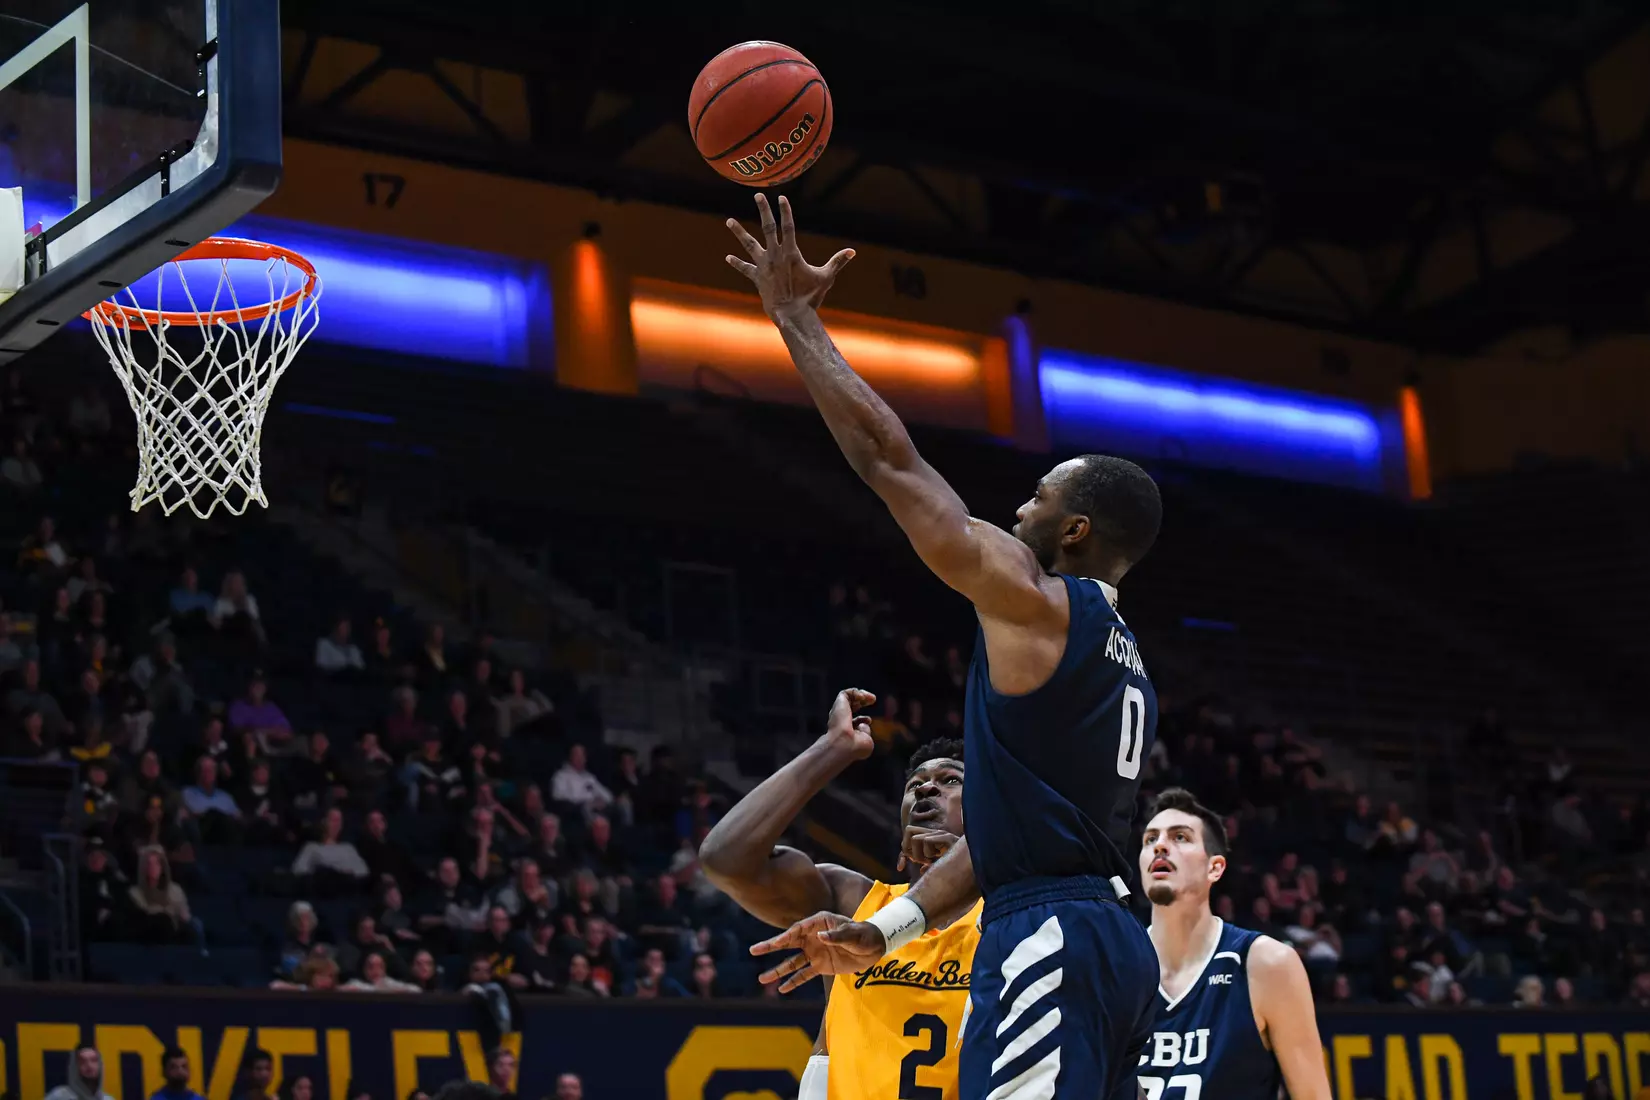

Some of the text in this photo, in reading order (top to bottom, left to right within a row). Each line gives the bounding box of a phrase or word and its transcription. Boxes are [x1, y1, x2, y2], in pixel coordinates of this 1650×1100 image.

[728, 112, 815, 177] Wilson
[363, 172, 405, 209] 17
[1105, 626, 1150, 681] ACQUA
[1117, 684, 1145, 780] 0
[1208, 973, 1232, 986] WAC
[898, 1013, 948, 1100] 2
